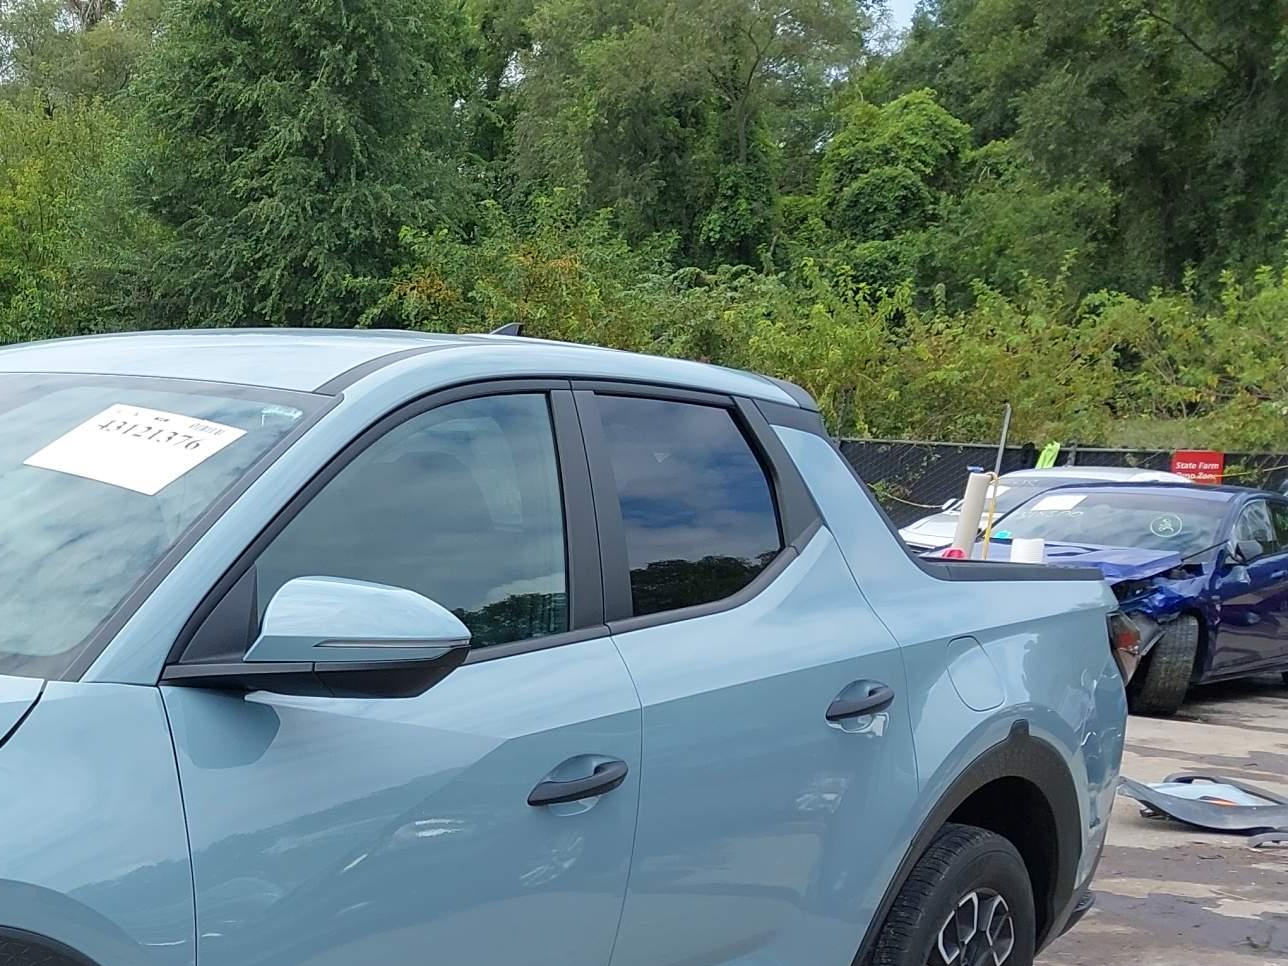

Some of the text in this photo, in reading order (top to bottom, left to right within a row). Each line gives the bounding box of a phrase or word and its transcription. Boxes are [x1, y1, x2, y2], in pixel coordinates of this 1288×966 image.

[98, 420, 202, 449] 43121376
[1175, 461, 1220, 469] State Farm
